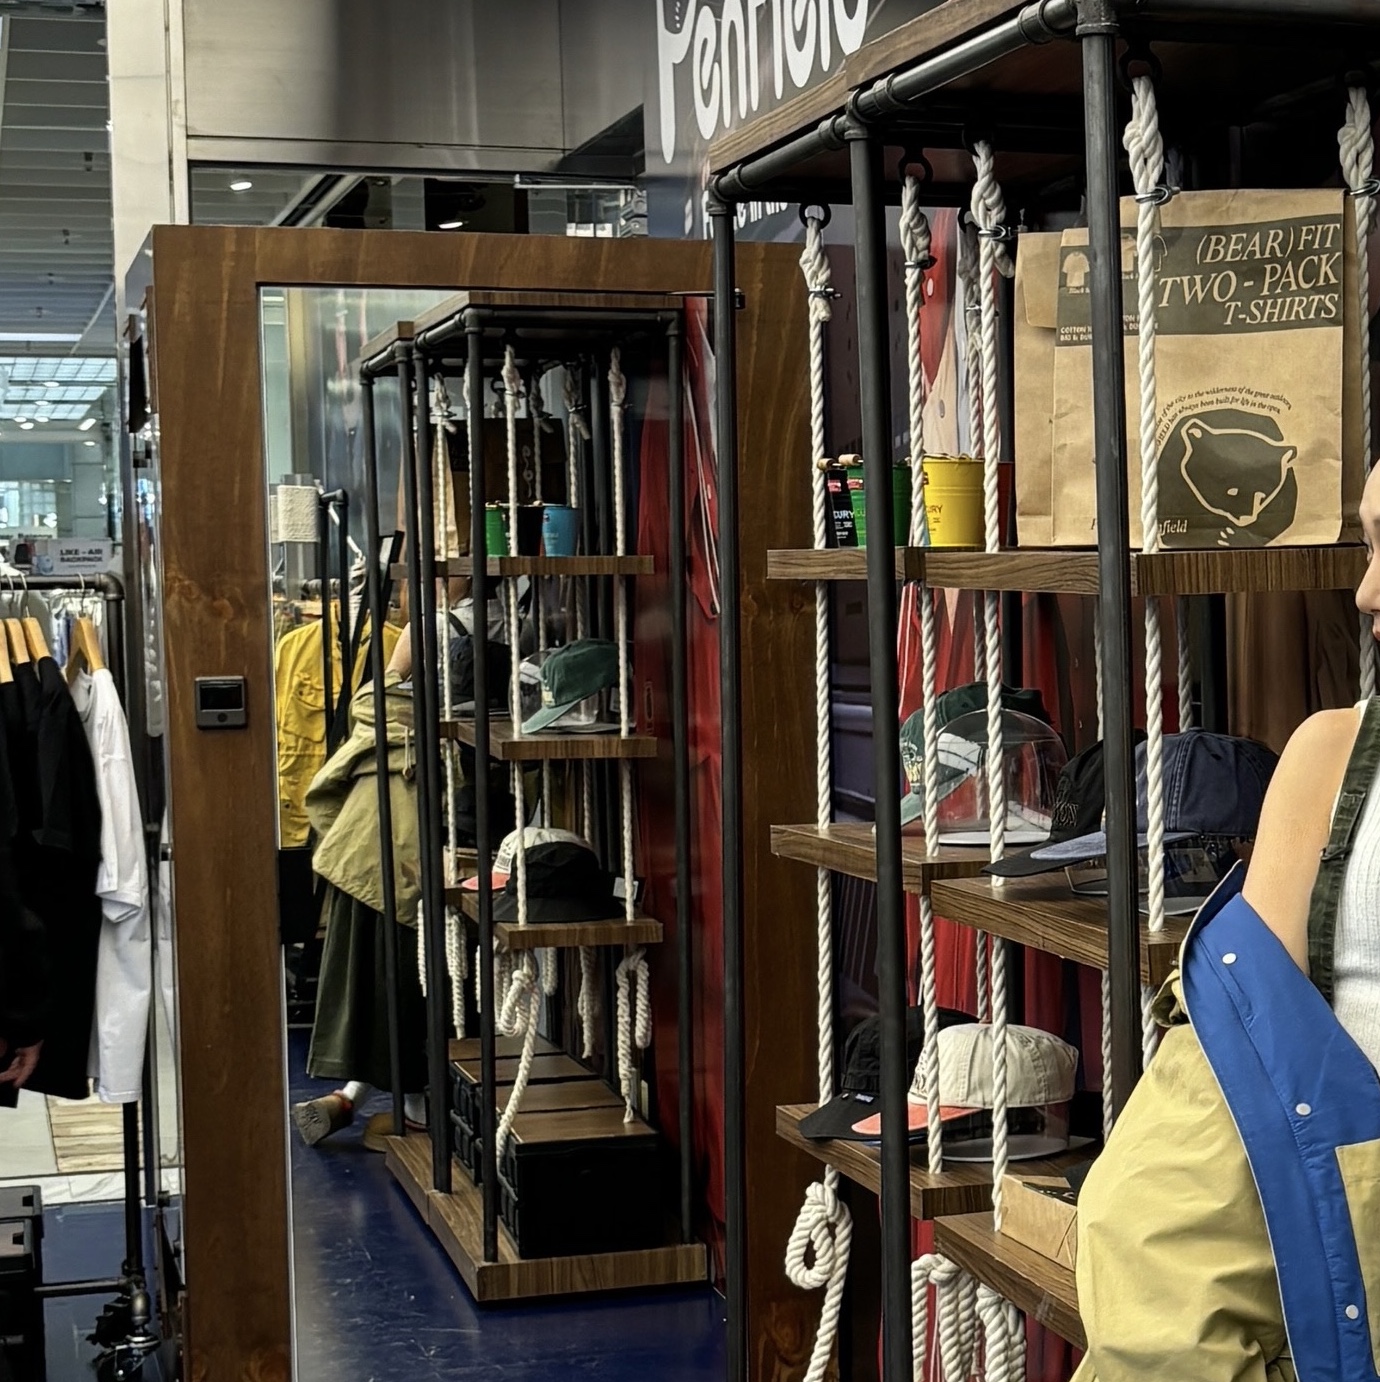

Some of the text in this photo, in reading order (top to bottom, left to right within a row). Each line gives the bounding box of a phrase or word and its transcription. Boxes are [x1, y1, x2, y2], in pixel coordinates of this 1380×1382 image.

[1196, 223, 1341, 265] (BEAR) FIT
[1223, 292, 1339, 326] T-SHIRTS
